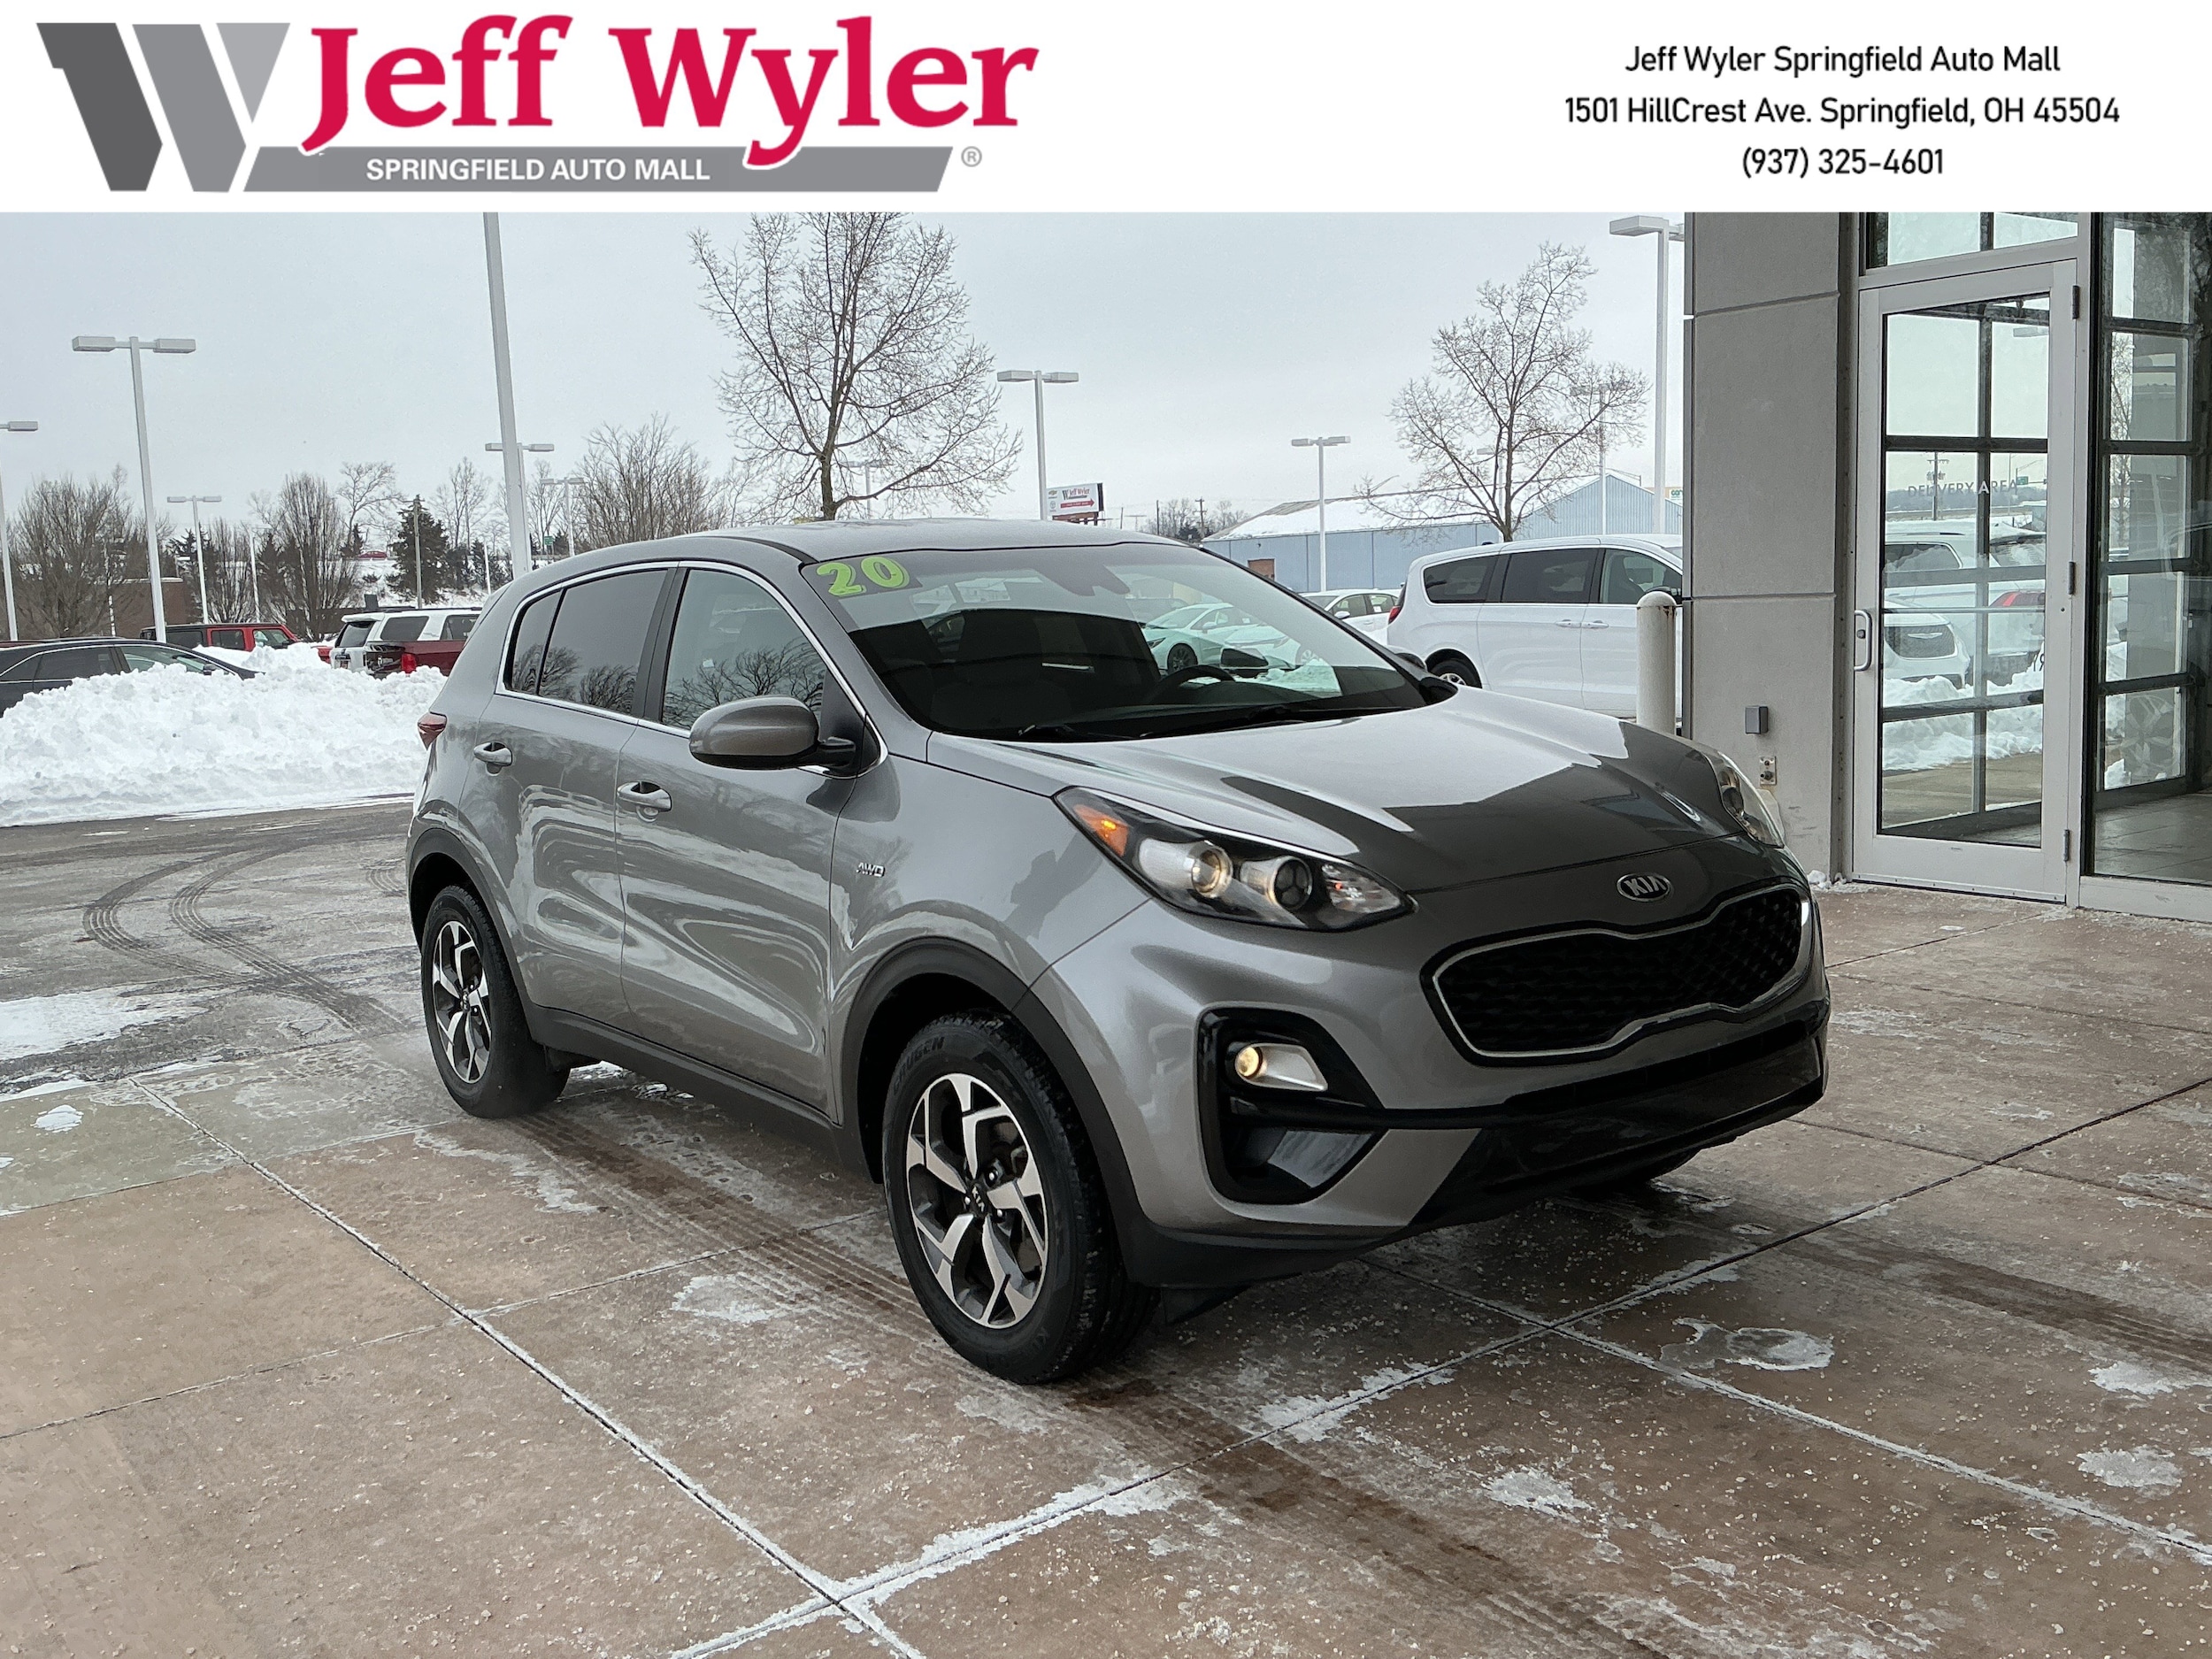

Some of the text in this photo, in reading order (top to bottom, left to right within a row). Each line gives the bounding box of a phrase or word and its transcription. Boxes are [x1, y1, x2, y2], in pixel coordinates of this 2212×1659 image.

[1908, 480, 2017, 497] DELIVERY AREA
[816, 556, 910, 597] 20
[856, 862, 886, 878] AWD
[1624, 875, 1667, 896] KIA
